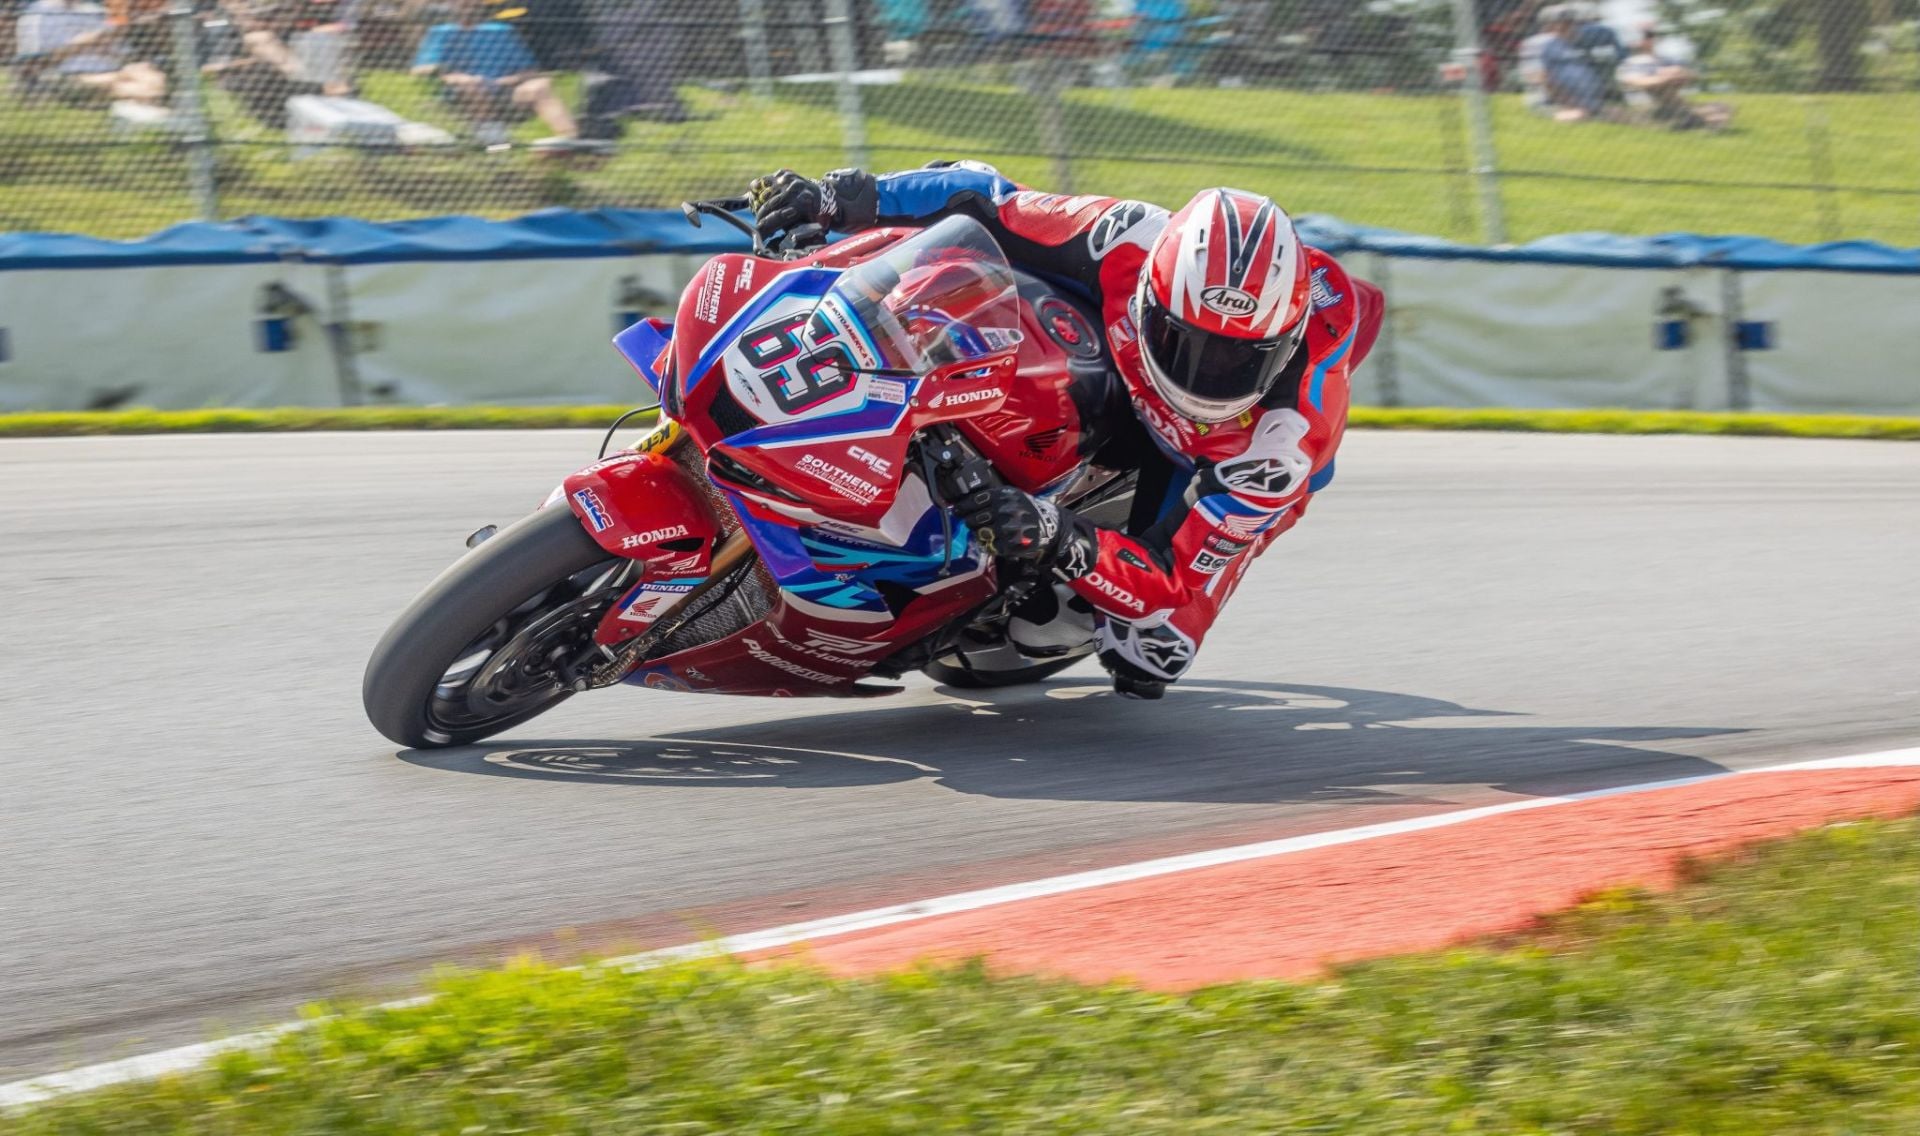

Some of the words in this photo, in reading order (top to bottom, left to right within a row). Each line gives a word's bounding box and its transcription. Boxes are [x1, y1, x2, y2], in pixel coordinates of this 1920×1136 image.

[706, 262, 727, 324] SOUTHERN
[1205, 290, 1251, 310] Arai
[738, 309, 860, 415] 69
[945, 387, 1004, 406] HONDA
[795, 460, 876, 503] POWERSPORTS
[801, 454, 883, 498] SOUTHERN
[573, 487, 615, 533] HRC
[622, 524, 689, 550] HONDA
[640, 583, 694, 593] DUNLOP
[1084, 572, 1145, 613] ONDA
[630, 611, 658, 619] HONDA
